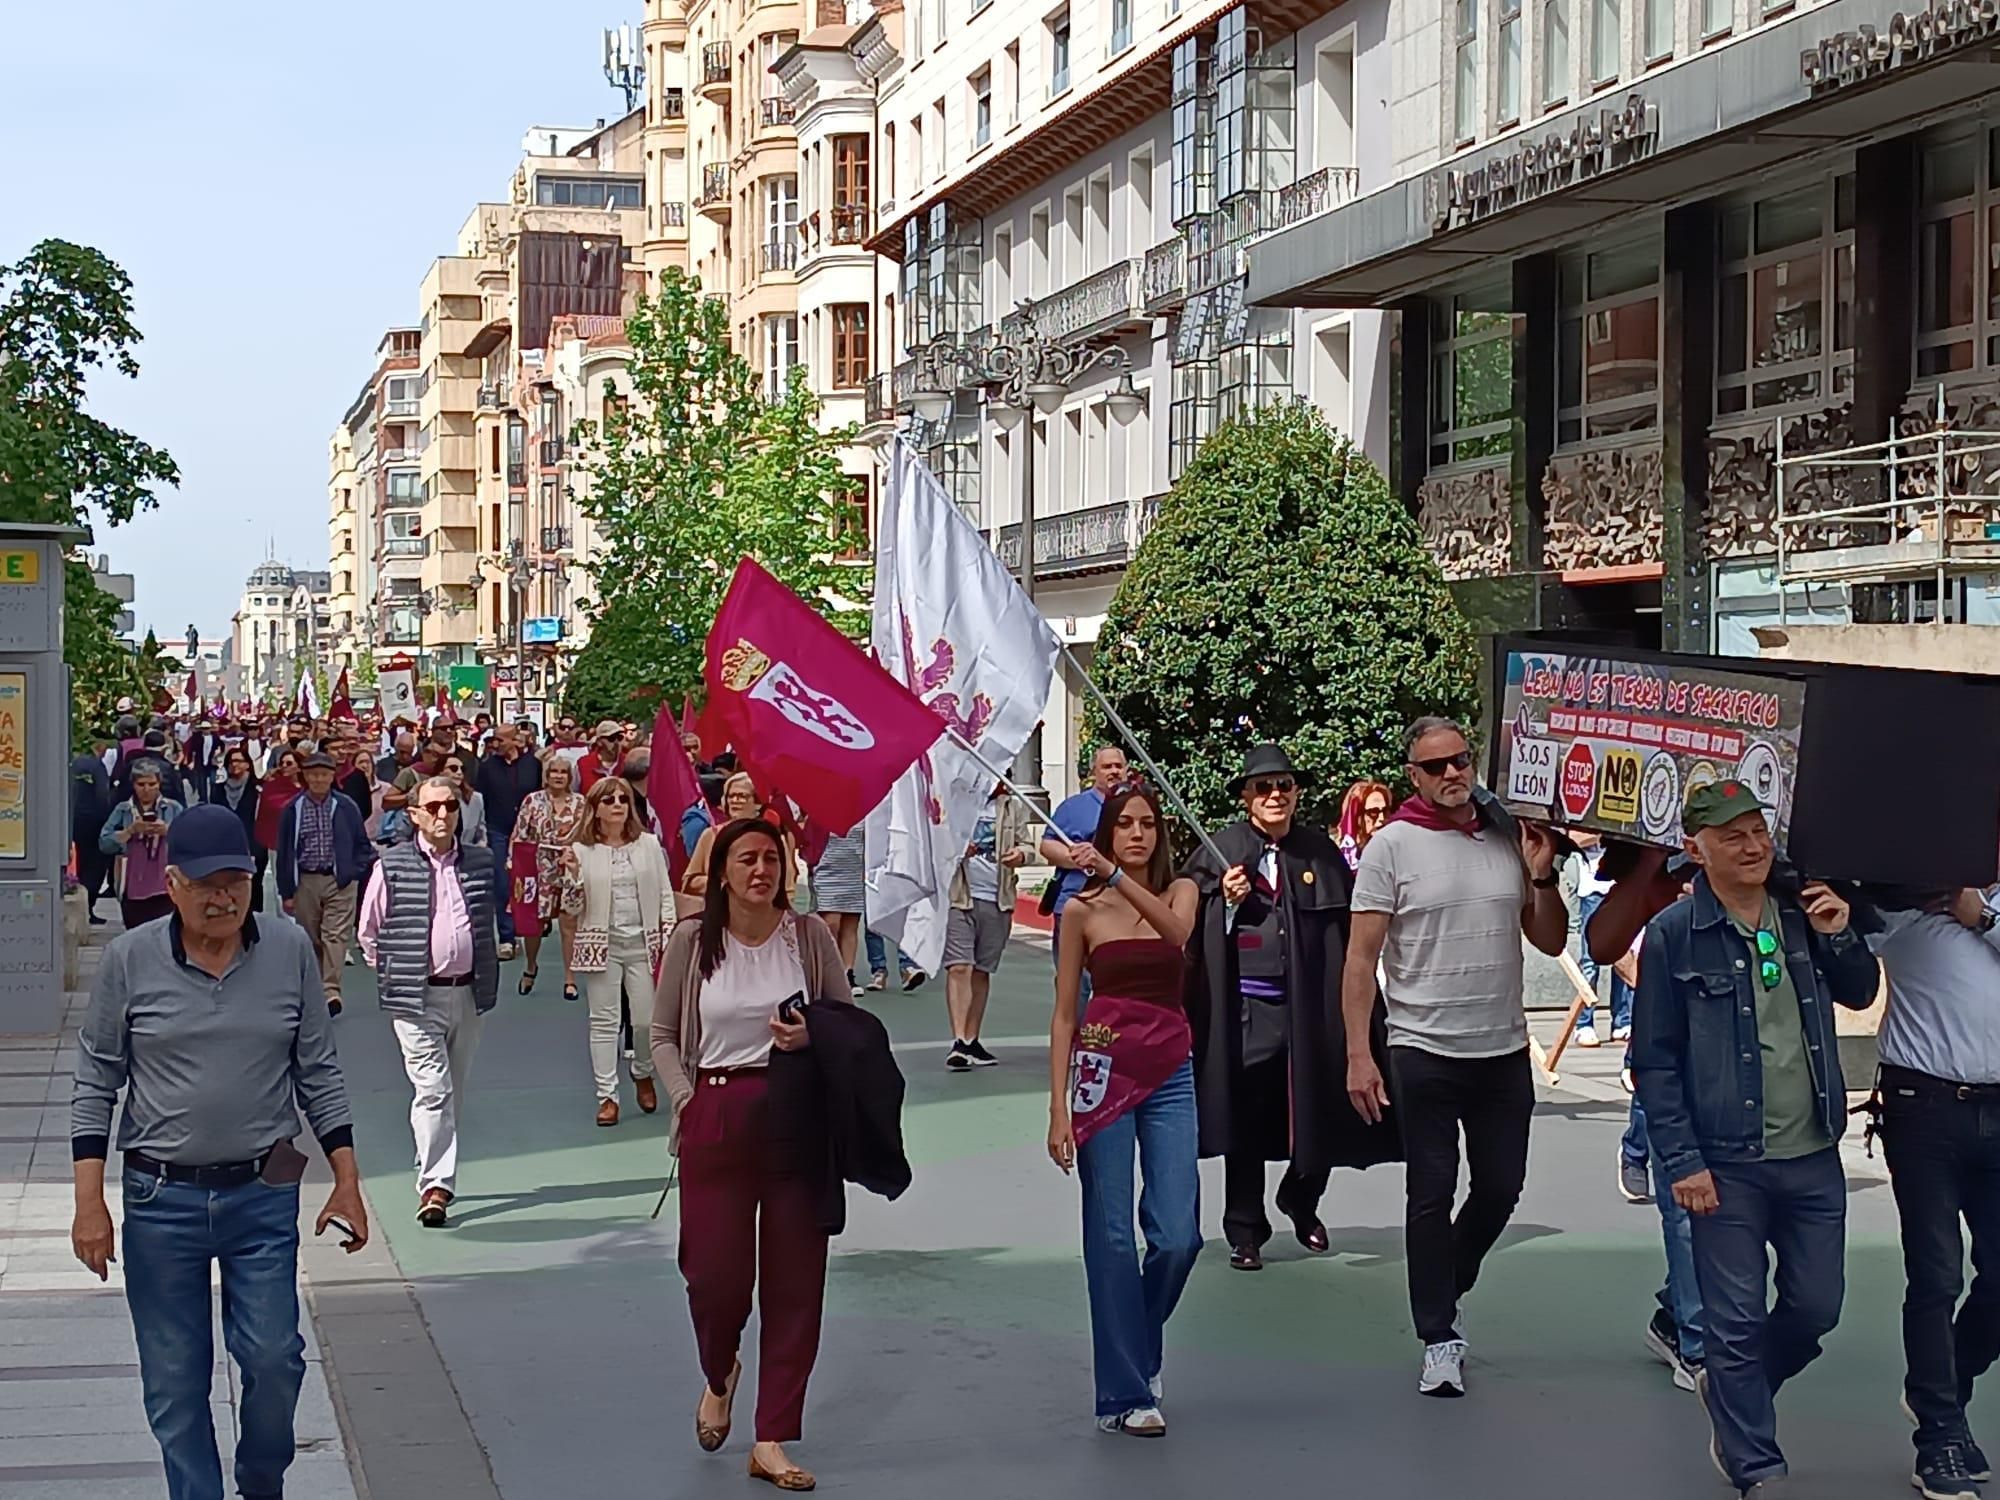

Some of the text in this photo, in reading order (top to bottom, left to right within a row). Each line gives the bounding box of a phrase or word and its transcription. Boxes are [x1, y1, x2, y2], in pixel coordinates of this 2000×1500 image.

[0, 555, 24, 578] E
[1523, 656, 1562, 698] LEÓN
[1588, 672, 1610, 703] ES
[1611, 674, 1662, 711] TIERRA
[1665, 680, 1689, 712] DE
[1691, 683, 1778, 728] SACRIFICIO
[1518, 743, 1550, 767] S.O.S
[1567, 760, 1593, 782] STOP
[1514, 770, 1548, 797] LEÓN
